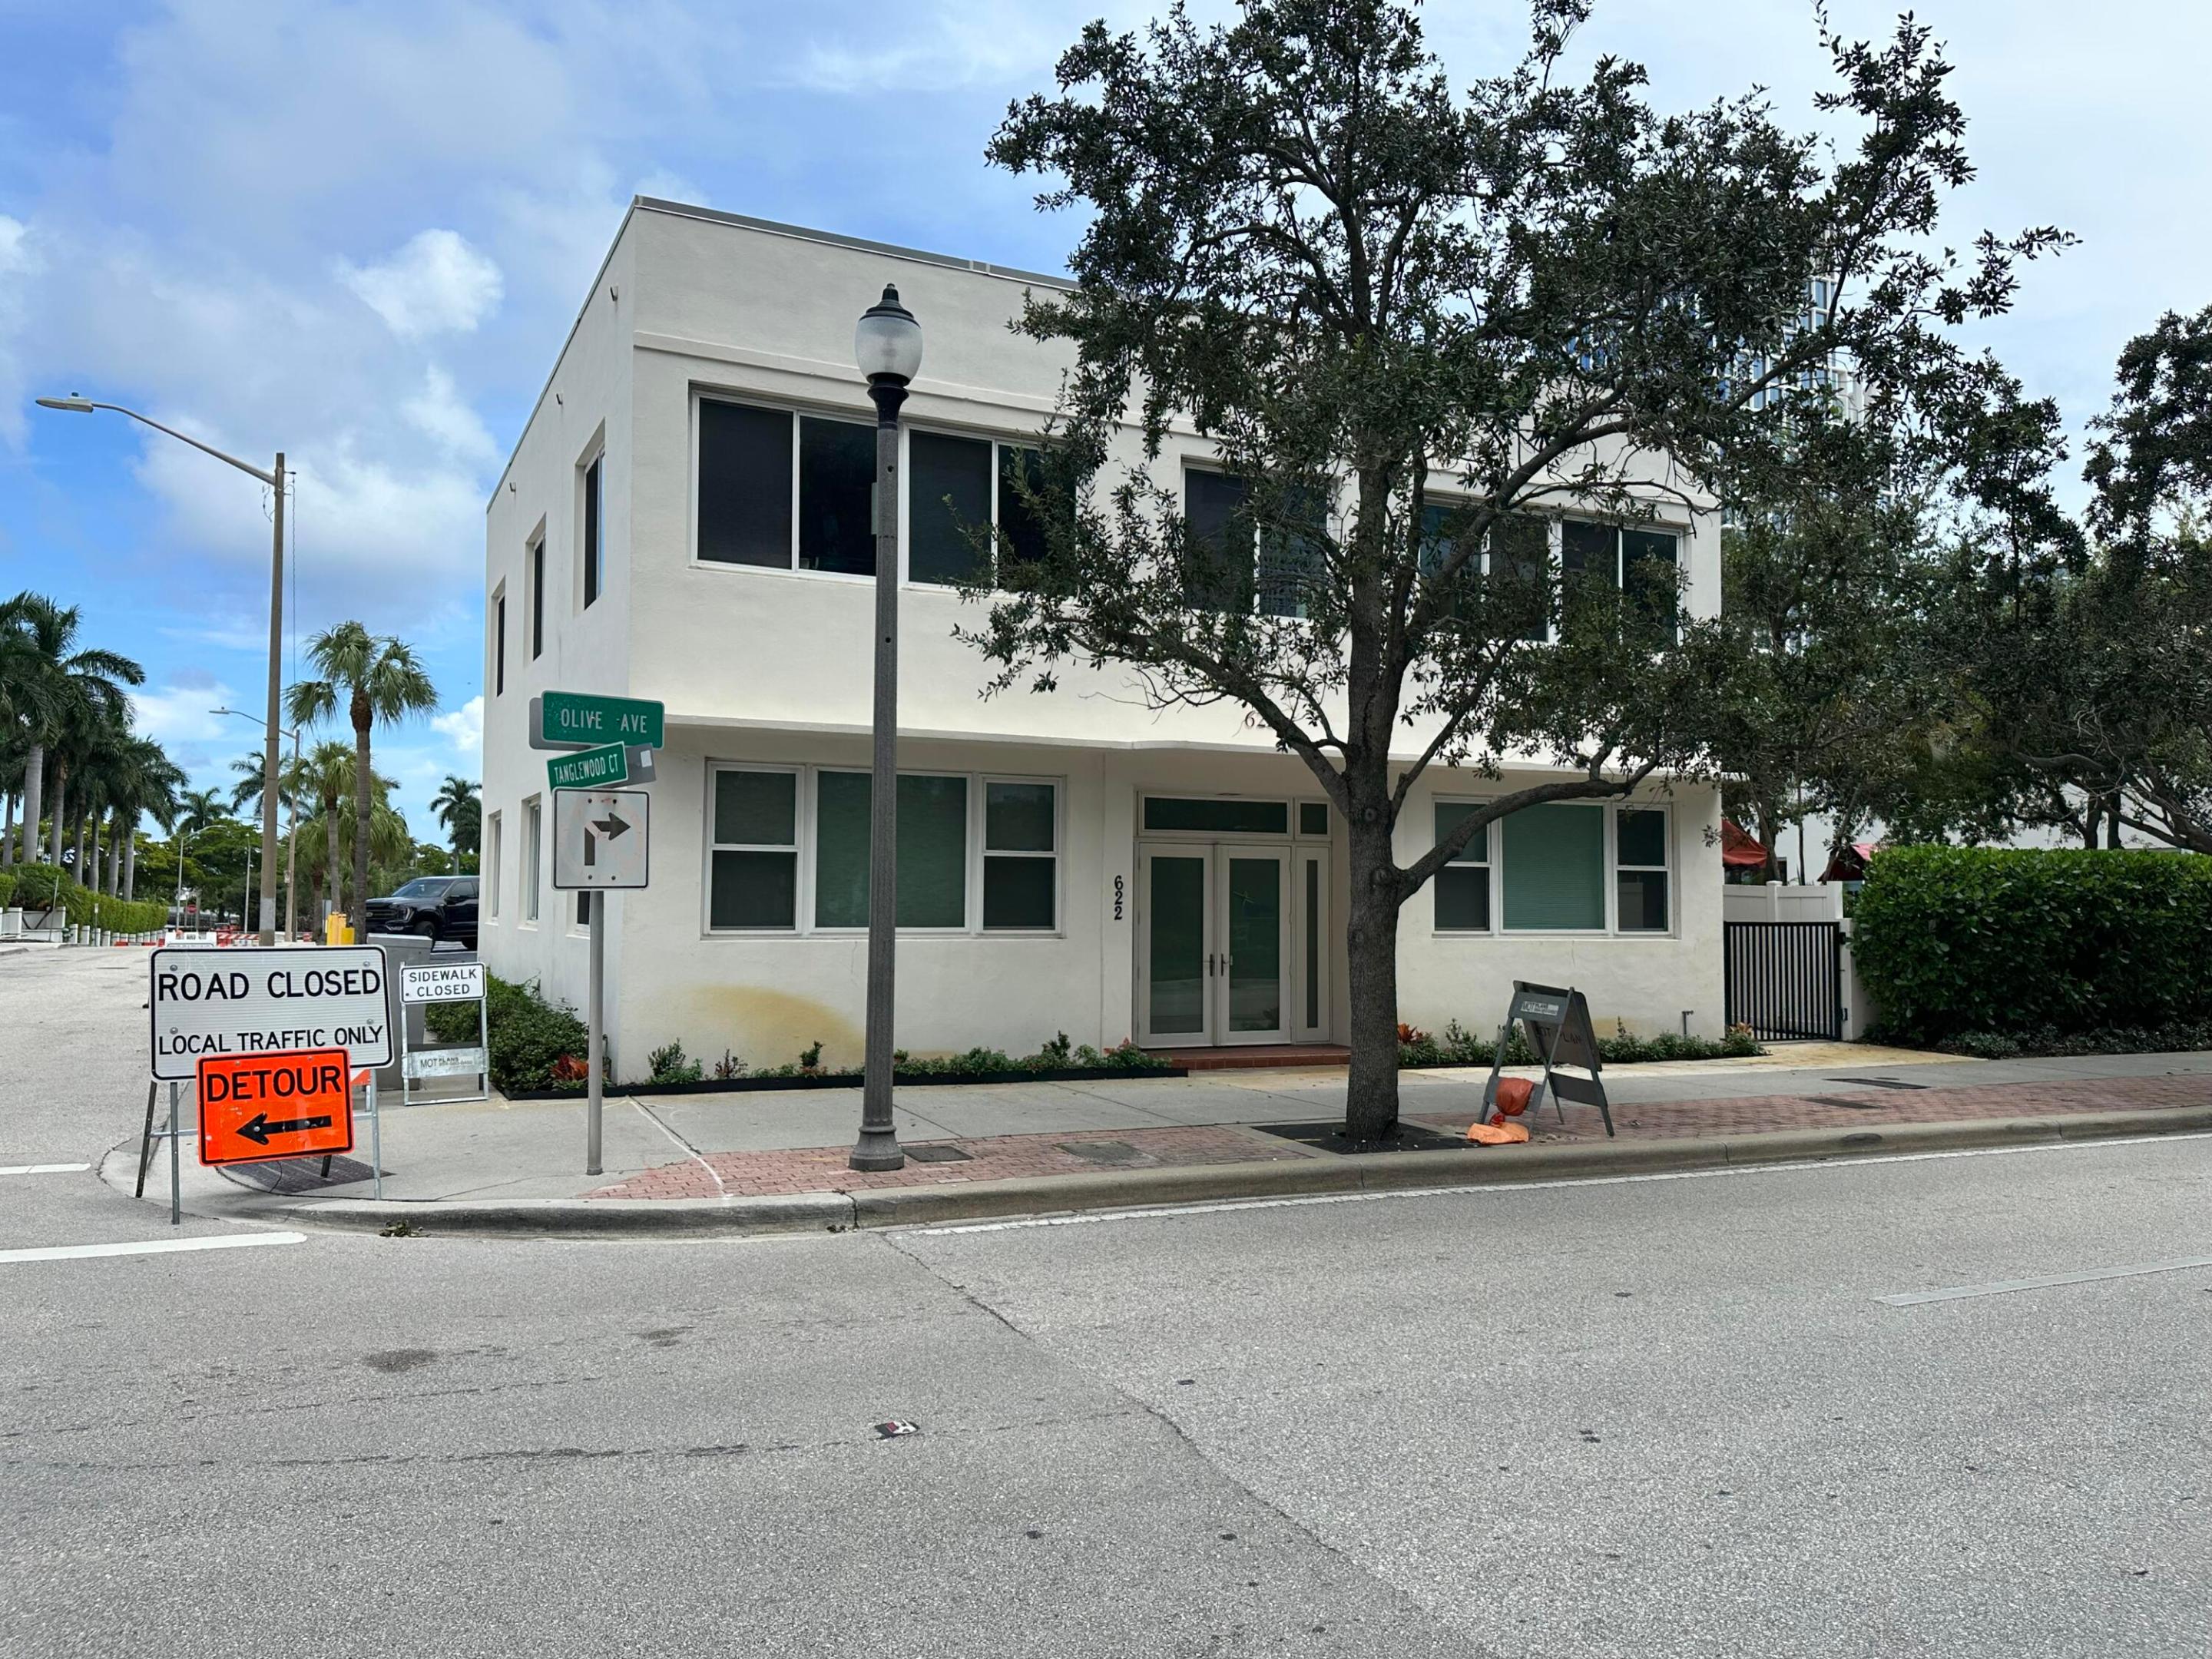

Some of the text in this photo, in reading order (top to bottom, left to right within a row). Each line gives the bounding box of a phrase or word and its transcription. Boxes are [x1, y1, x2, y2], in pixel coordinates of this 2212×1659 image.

[561, 708, 647, 733] OLIVE AVE
[554, 753, 619, 784] TANGLEWOOD CT
[1114, 875, 1124, 921] 622
[158, 969, 381, 1002] ROAD CLOSED
[409, 969, 477, 983] SIDEWALK
[417, 984, 470, 997] CLOSED
[159, 1025, 383, 1055] LOCAL TRAFFIC ONLY
[207, 1065, 343, 1103] DETOUR
